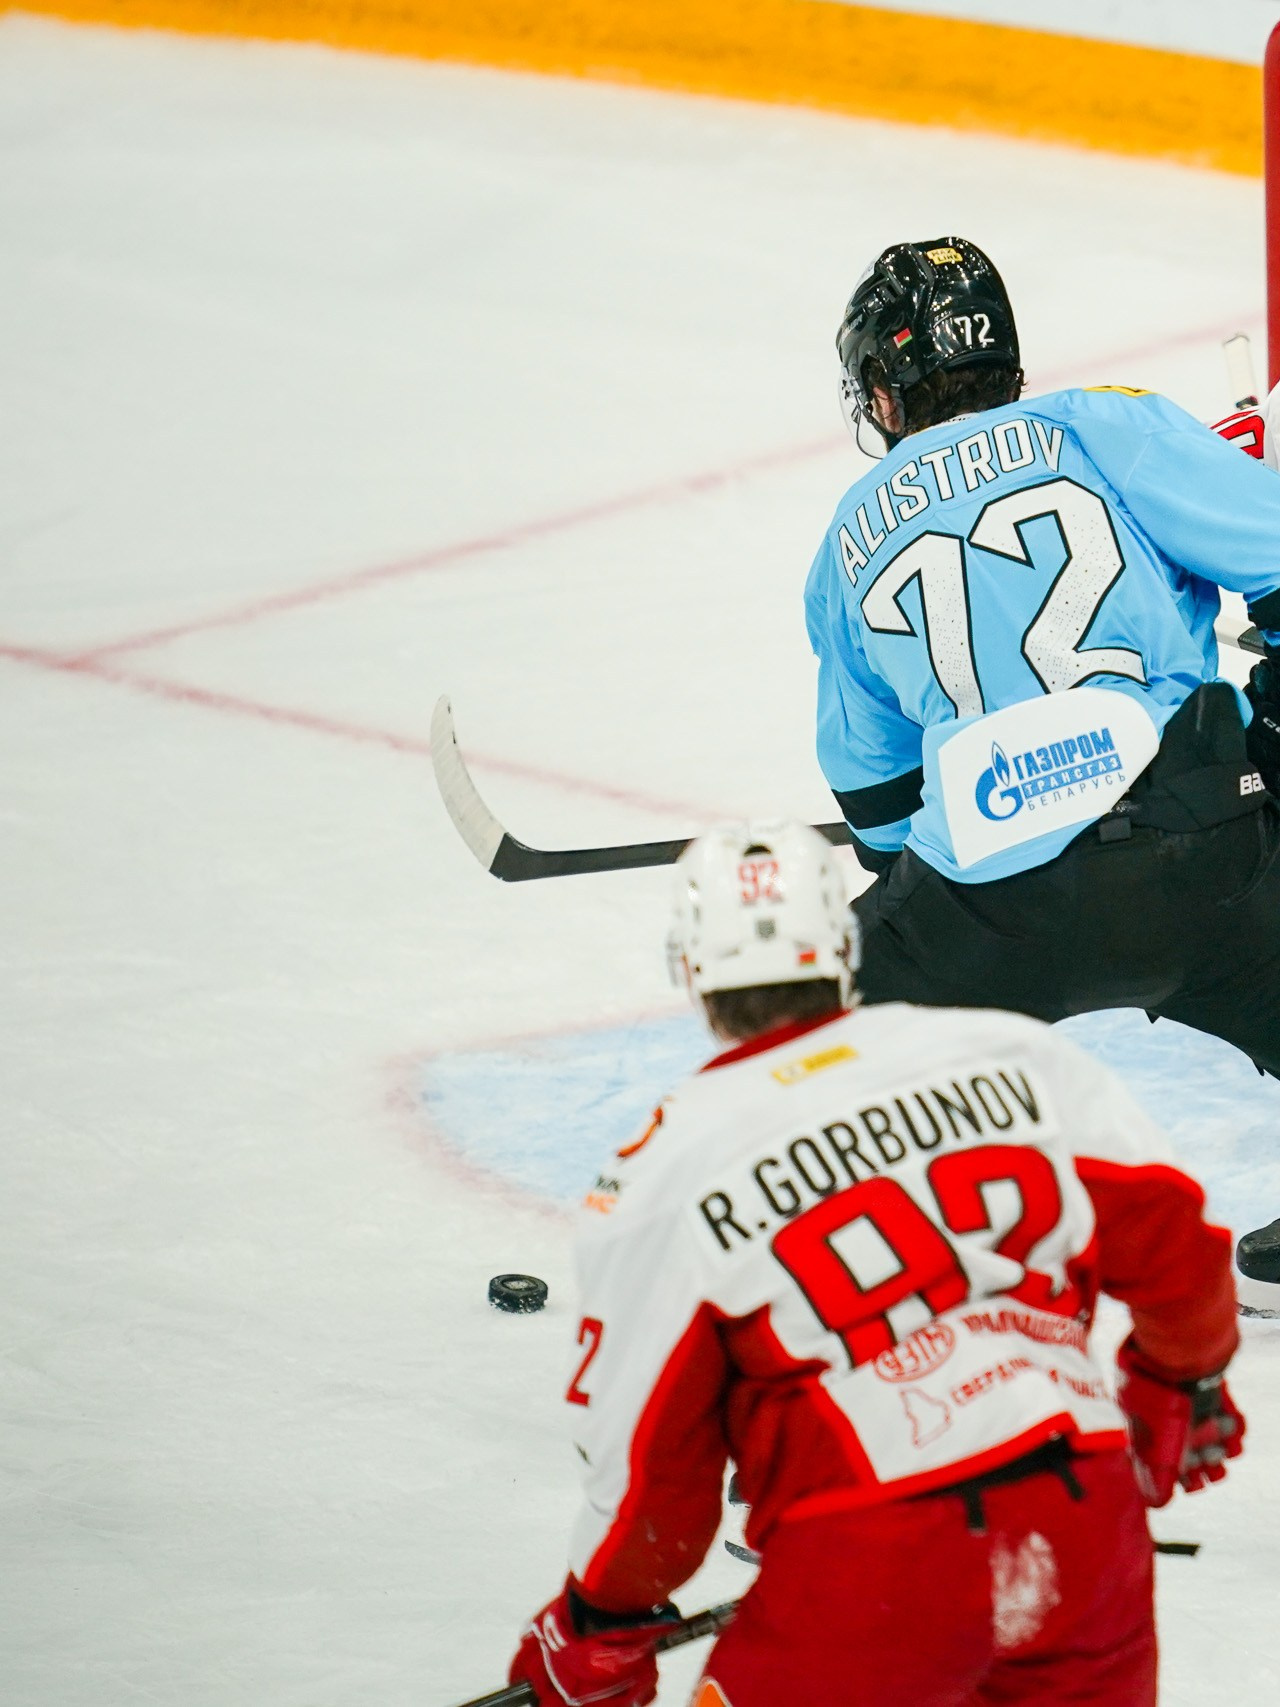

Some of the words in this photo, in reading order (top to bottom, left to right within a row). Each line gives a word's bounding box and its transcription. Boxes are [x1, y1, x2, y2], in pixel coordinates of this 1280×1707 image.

[954, 312, 995, 346] 72
[836, 418, 1065, 588] ALISTROV
[860, 475, 1150, 720] 72
[1013, 727, 1116, 781] ГАЗПРОМ
[1024, 755, 1121, 797] ТРАНСГАЗ
[1027, 772, 1127, 811] БЕЛАРУСЬ
[738, 861, 785, 904] 92
[698, 1068, 1043, 1252] R.GORBUNOV
[772, 1144, 1090, 1368] 92
